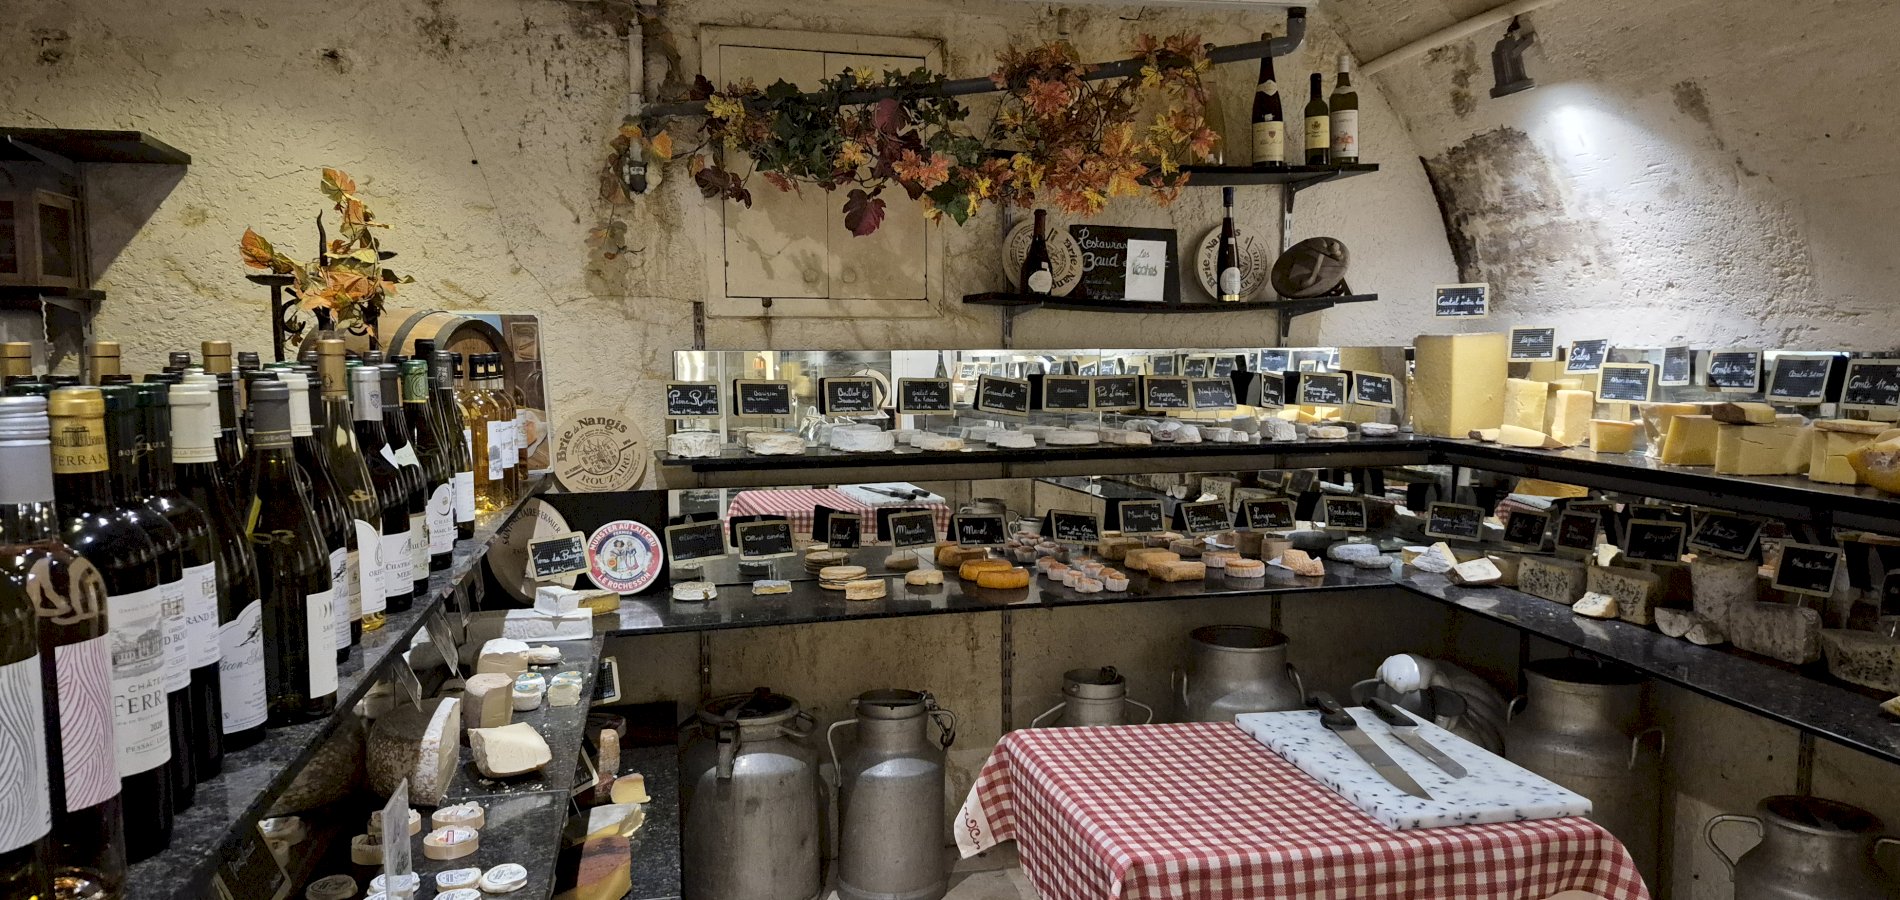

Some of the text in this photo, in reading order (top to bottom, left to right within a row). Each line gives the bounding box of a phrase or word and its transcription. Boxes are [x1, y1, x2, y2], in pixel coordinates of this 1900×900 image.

[1083, 251, 1119, 272] Baud
[1849, 375, 1873, 389] Comté
[556, 430, 574, 463] Brie
[577, 416, 628, 434] Nangis
[581, 452, 632, 486] ROUZAIRE
[590, 524, 617, 551] MUNSTER
[630, 524, 646, 536] LAIT
[645, 533, 657, 547] CRU
[597, 571, 652, 590] LE ROCHESSON
